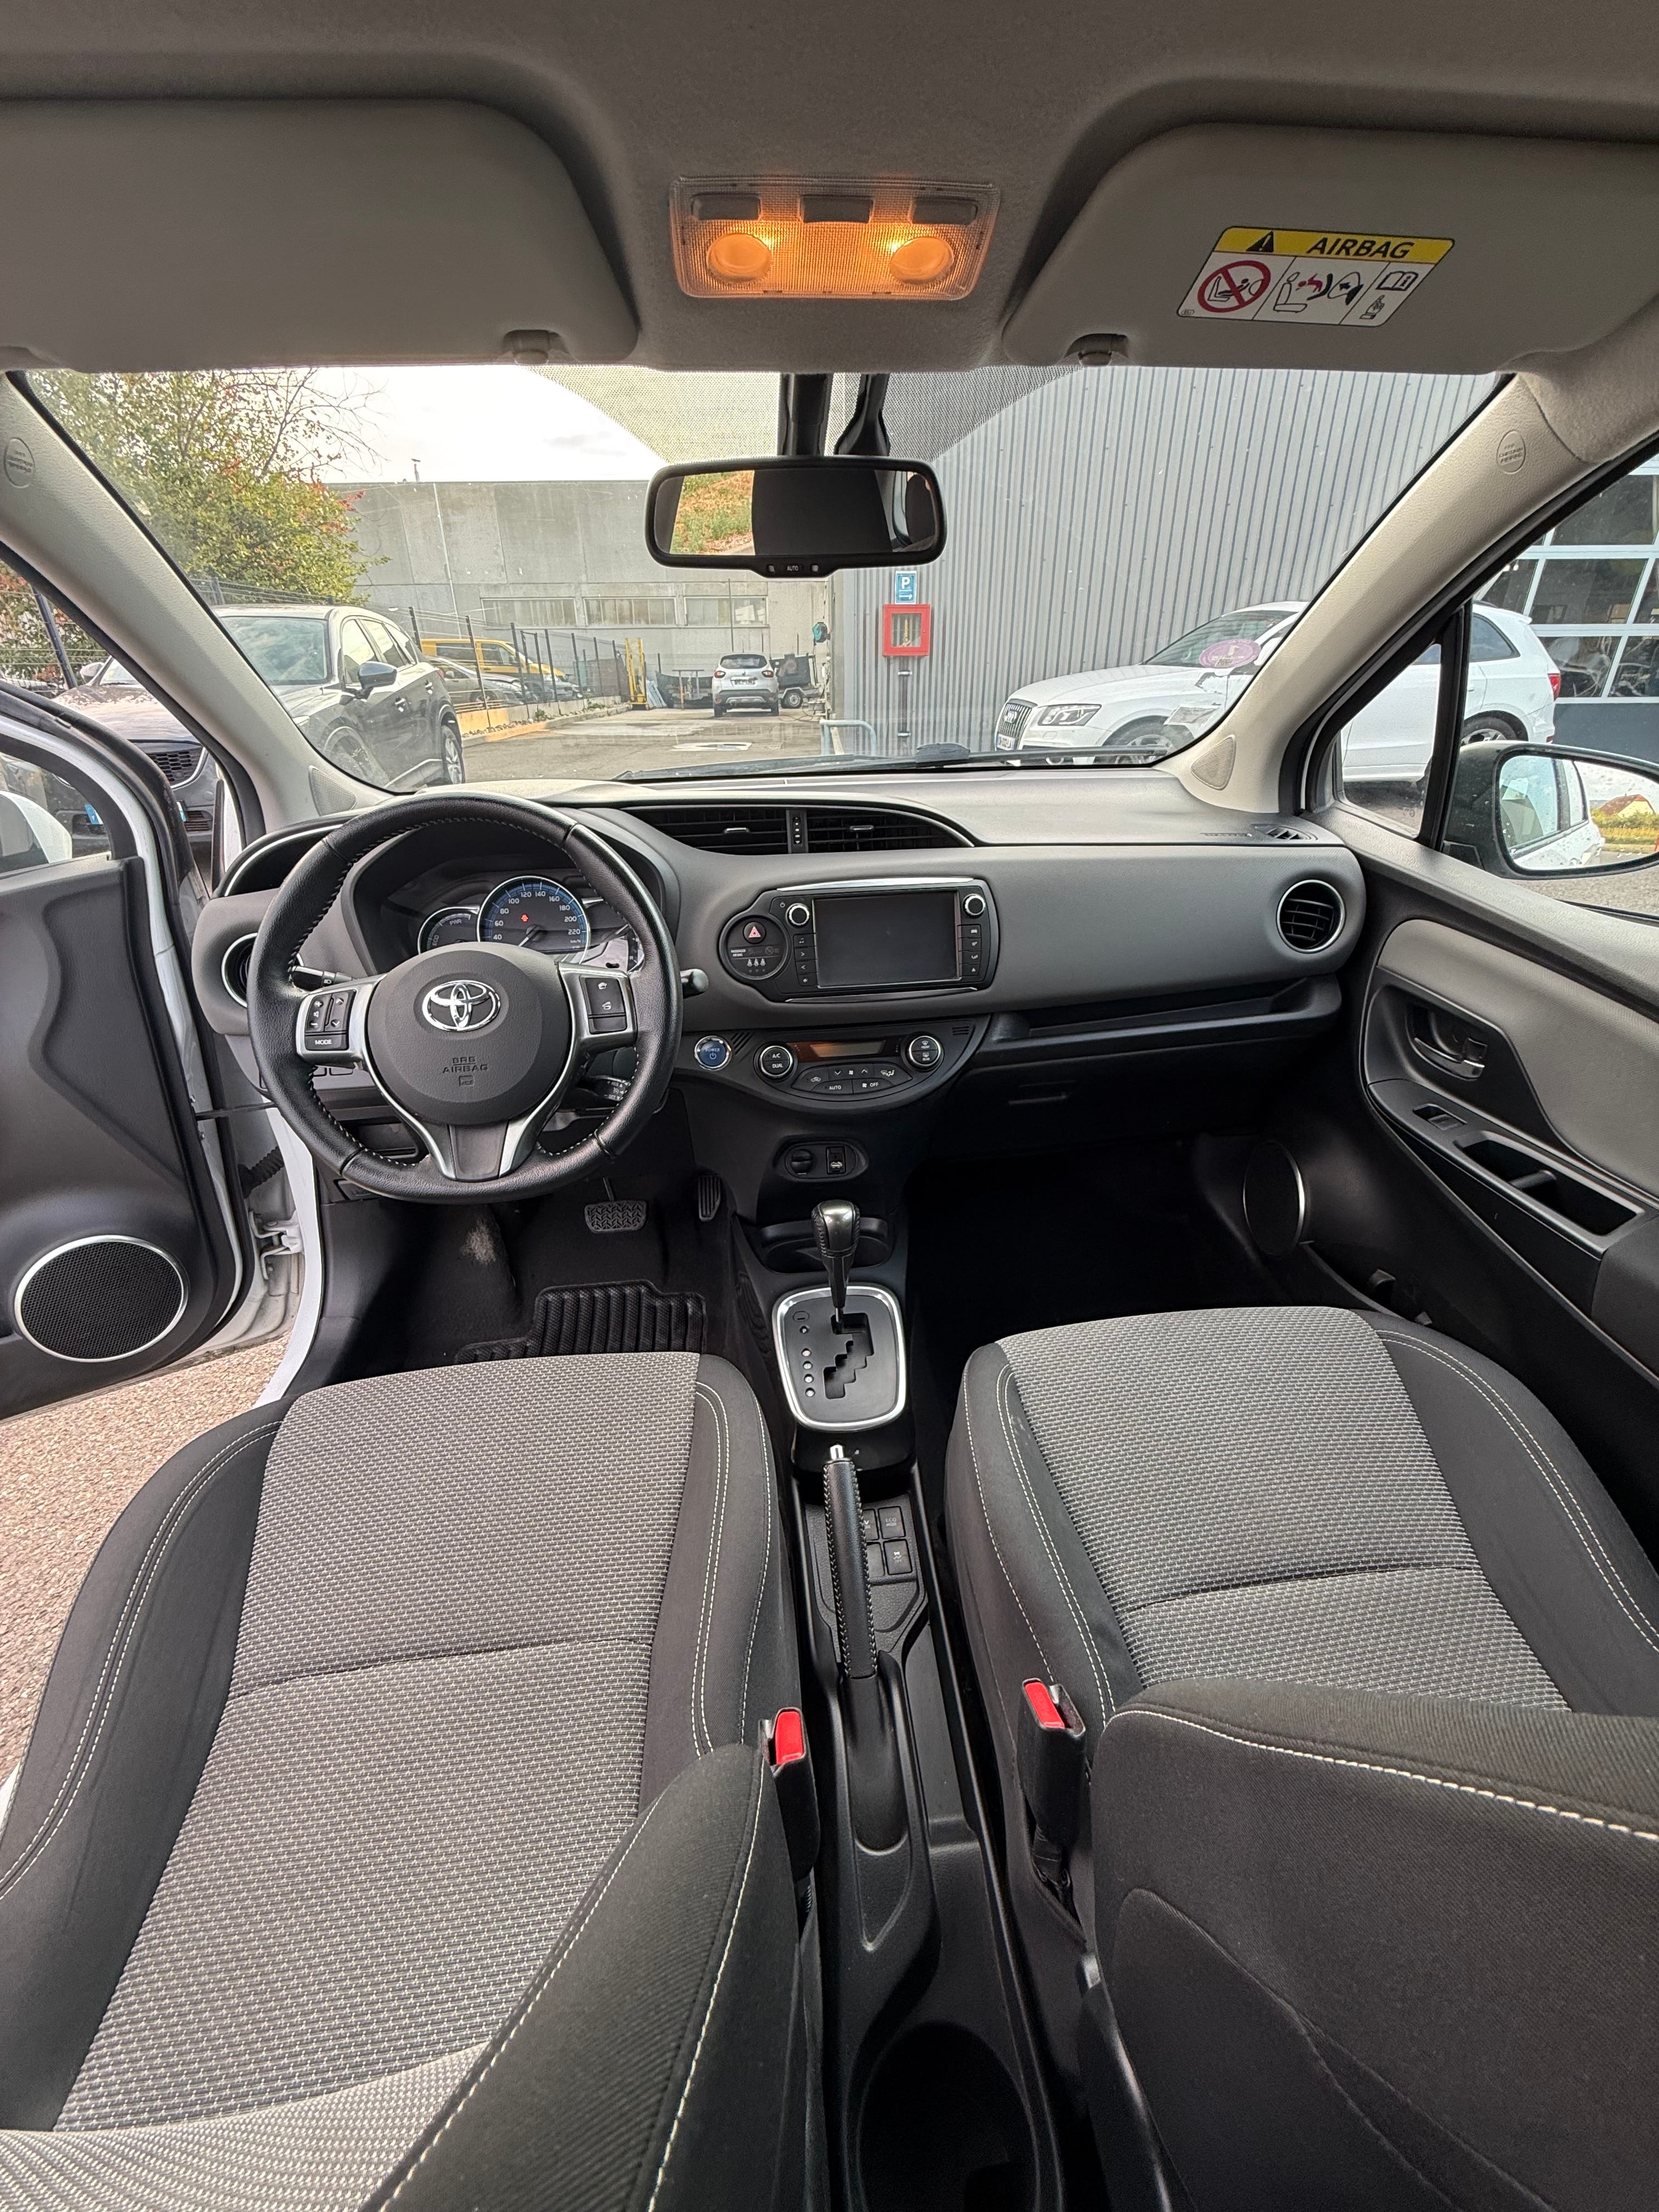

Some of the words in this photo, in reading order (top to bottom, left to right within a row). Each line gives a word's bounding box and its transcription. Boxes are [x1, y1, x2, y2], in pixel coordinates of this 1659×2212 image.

[1306, 238, 1415, 259] AIRBAG
[901, 577, 910, 589] P
[443, 1064, 488, 1074] AIRBAG
